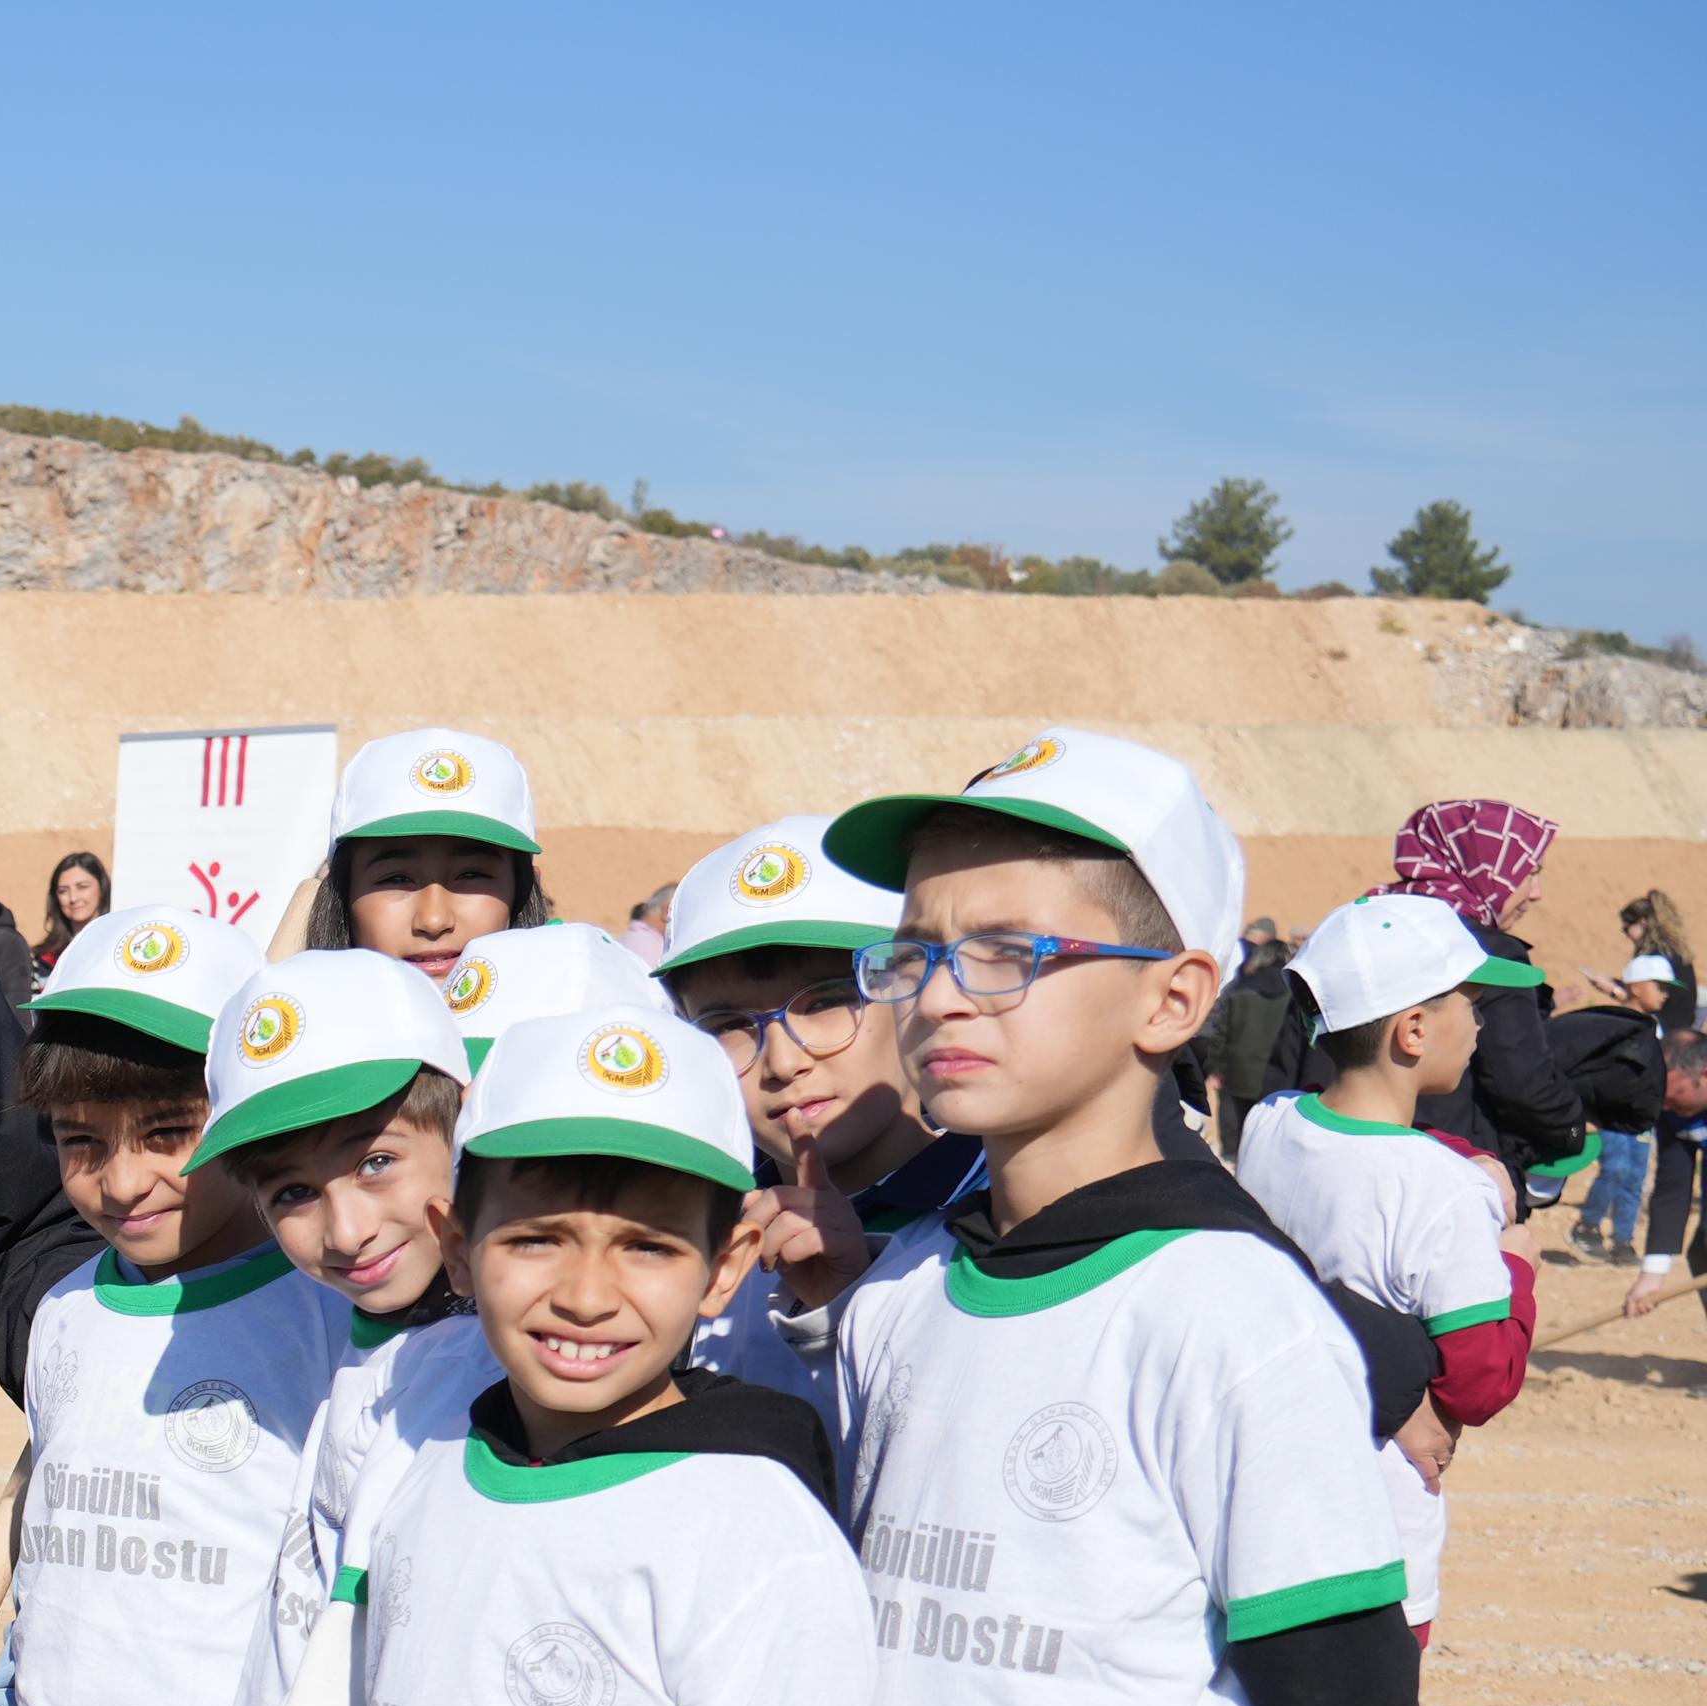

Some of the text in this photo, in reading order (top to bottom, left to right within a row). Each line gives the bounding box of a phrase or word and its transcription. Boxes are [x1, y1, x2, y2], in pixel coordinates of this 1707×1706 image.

[750, 887, 769, 897] OGM
[187, 1436, 208, 1457] OGM
[43, 1462, 162, 1521] Gönüllü
[1029, 1480, 1053, 1503] OGM
[95, 1523, 228, 1585] Dostu
[913, 1597, 1064, 1675] Dostu
